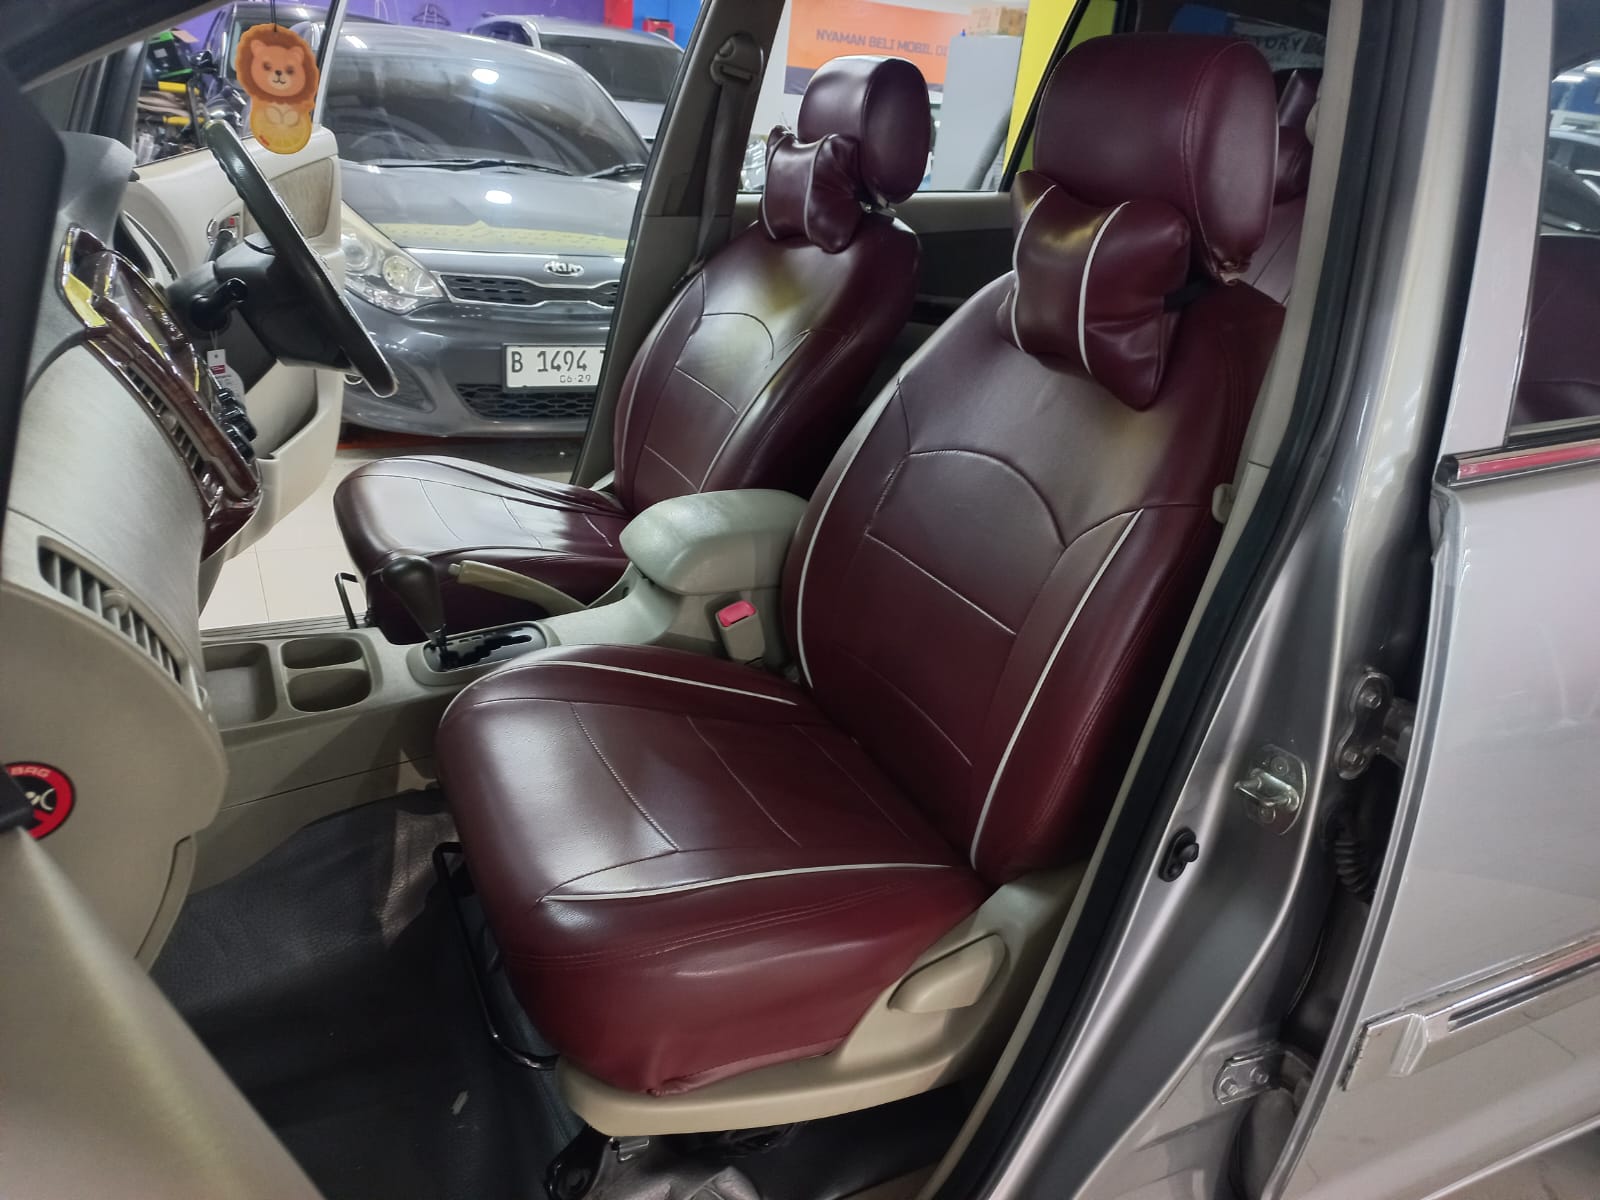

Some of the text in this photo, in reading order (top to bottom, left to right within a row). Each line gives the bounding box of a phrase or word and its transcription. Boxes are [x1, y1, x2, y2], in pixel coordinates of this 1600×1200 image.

[816, 29, 866, 46] NYAMAN
[869, 37, 895, 50] BELI
[897, 41, 932, 55] MOBIL
[511, 351, 523, 373] B
[537, 350, 588, 373] 1494
